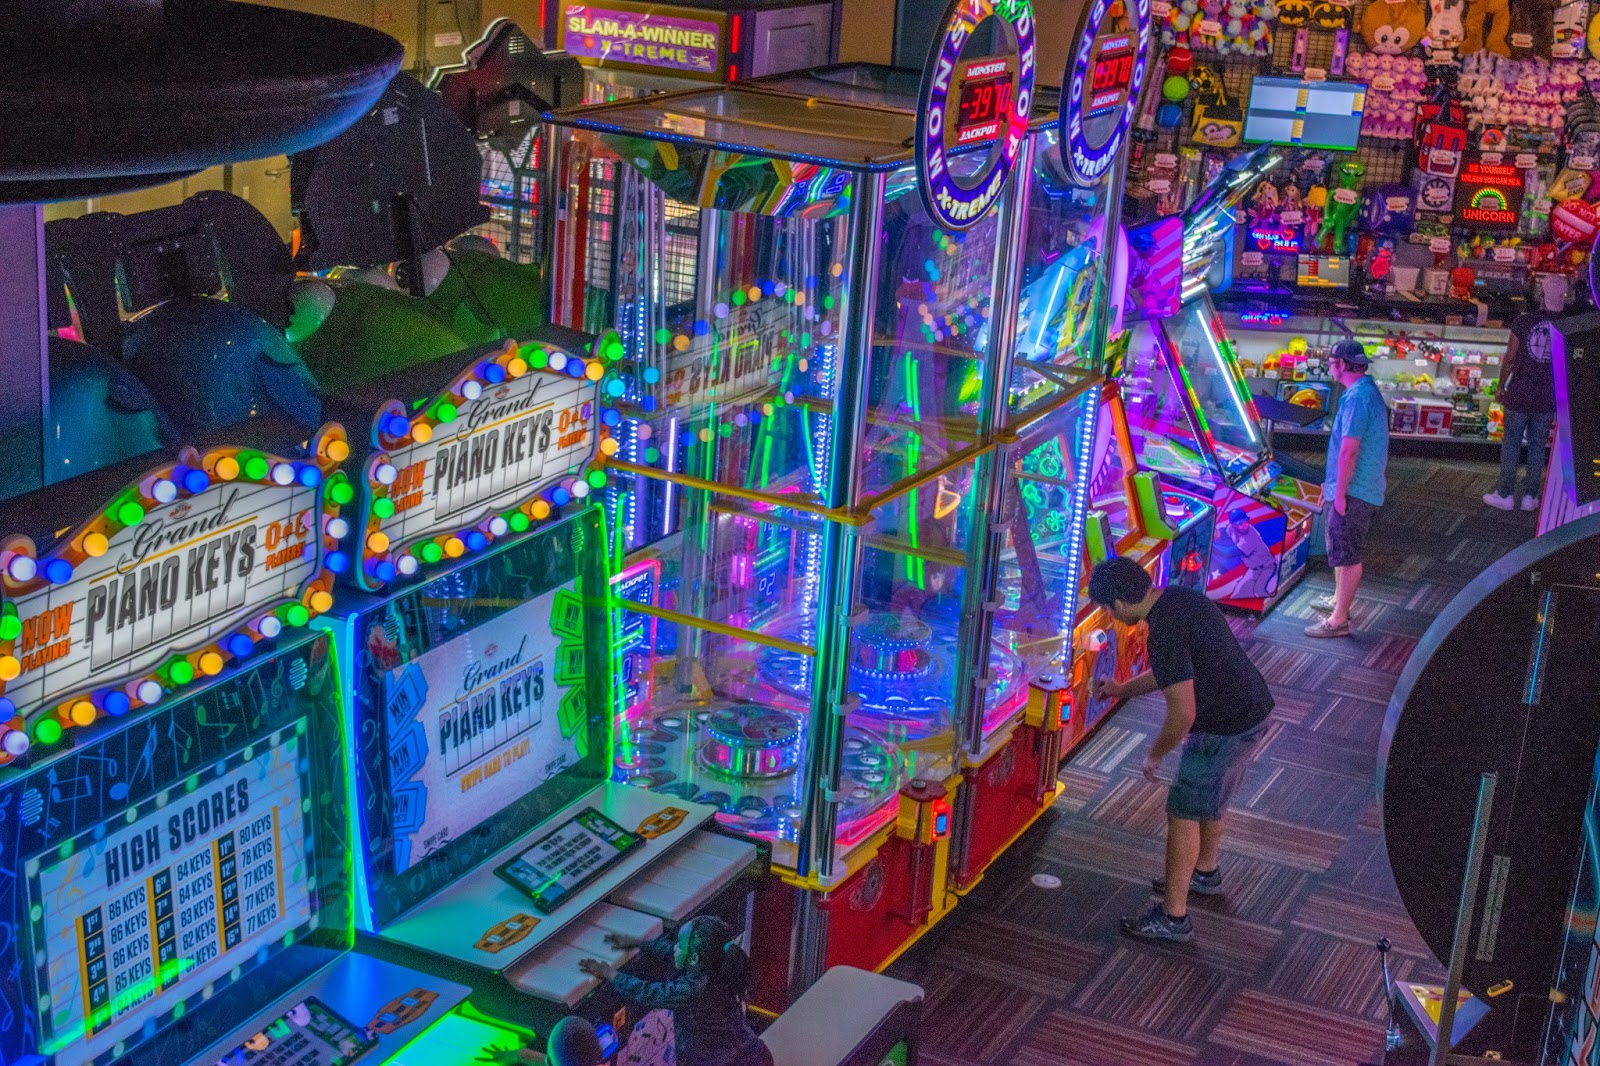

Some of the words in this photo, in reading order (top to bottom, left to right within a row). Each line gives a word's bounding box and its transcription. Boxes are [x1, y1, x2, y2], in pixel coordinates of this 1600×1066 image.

[568, 17, 716, 50] SLAM-A-WINNER
[1102, 38, 1129, 52] MONSTER
[601, 39, 689, 63] X-TREME
[966, 62, 1007, 78] MONSTER
[1091, 92, 1120, 108] JACKPOT
[958, 124, 998, 142] JACKPOT
[1480, 164, 1516, 176] YOURSELF
[1462, 209, 1516, 223] UNICORN
[456, 377, 543, 441] Grand
[433, 428, 499, 496] PIANO
[501, 408, 554, 468] KEYS
[116, 487, 240, 575] Grand
[85, 552, 181, 644] PIANO
[185, 524, 258, 601] KEYS
[615, 572, 649, 594] JACKPOT
[21, 600, 75, 649] NOW
[20, 637, 72, 675] PLAYING!
[455, 634, 528, 703] Grand
[389, 687, 410, 719] WIN
[439, 685, 497, 755] PIANO
[500, 660, 545, 721] KEYS
[390, 742, 411, 769] WIN
[105, 824, 161, 887] HIGH
[168, 777, 249, 852] SCORES
[239, 828, 250, 845] 80
[251, 814, 272, 839] KEYS
[241, 850, 252, 869] 78
[252, 836, 273, 860] KEYS
[154, 876, 168, 895] 6TH
[176, 864, 189, 882] 84
[190, 848, 211, 873] KEYS
[178, 887, 191, 905] 84
[191, 871, 213, 896] KEYS
[243, 871, 253, 890] 77
[253, 858, 274, 882] KEYS
[86, 912, 99, 934] 1ST
[108, 901, 121, 921] 86
[122, 886, 146, 914] KEYS
[245, 893, 255, 913] 77
[255, 880, 276, 905] KEYS
[110, 925, 123, 945] 86
[124, 909, 148, 938] KEYS
[158, 919, 171, 939] 8TH
[180, 909, 193, 928] 83
[193, 894, 215, 919] KEYS
[246, 915, 257, 935] 77
[256, 902, 277, 926] KEYS
[112, 949, 125, 969] 86
[126, 933, 150, 962] KEYS
[160, 943, 173, 963] 9TH
[182, 932, 195, 951] 82
[195, 917, 217, 942] KEYS
[196, 940, 217, 965] KEYS
[115, 973, 128, 993] 85
[128, 956, 151, 986] KEYS
